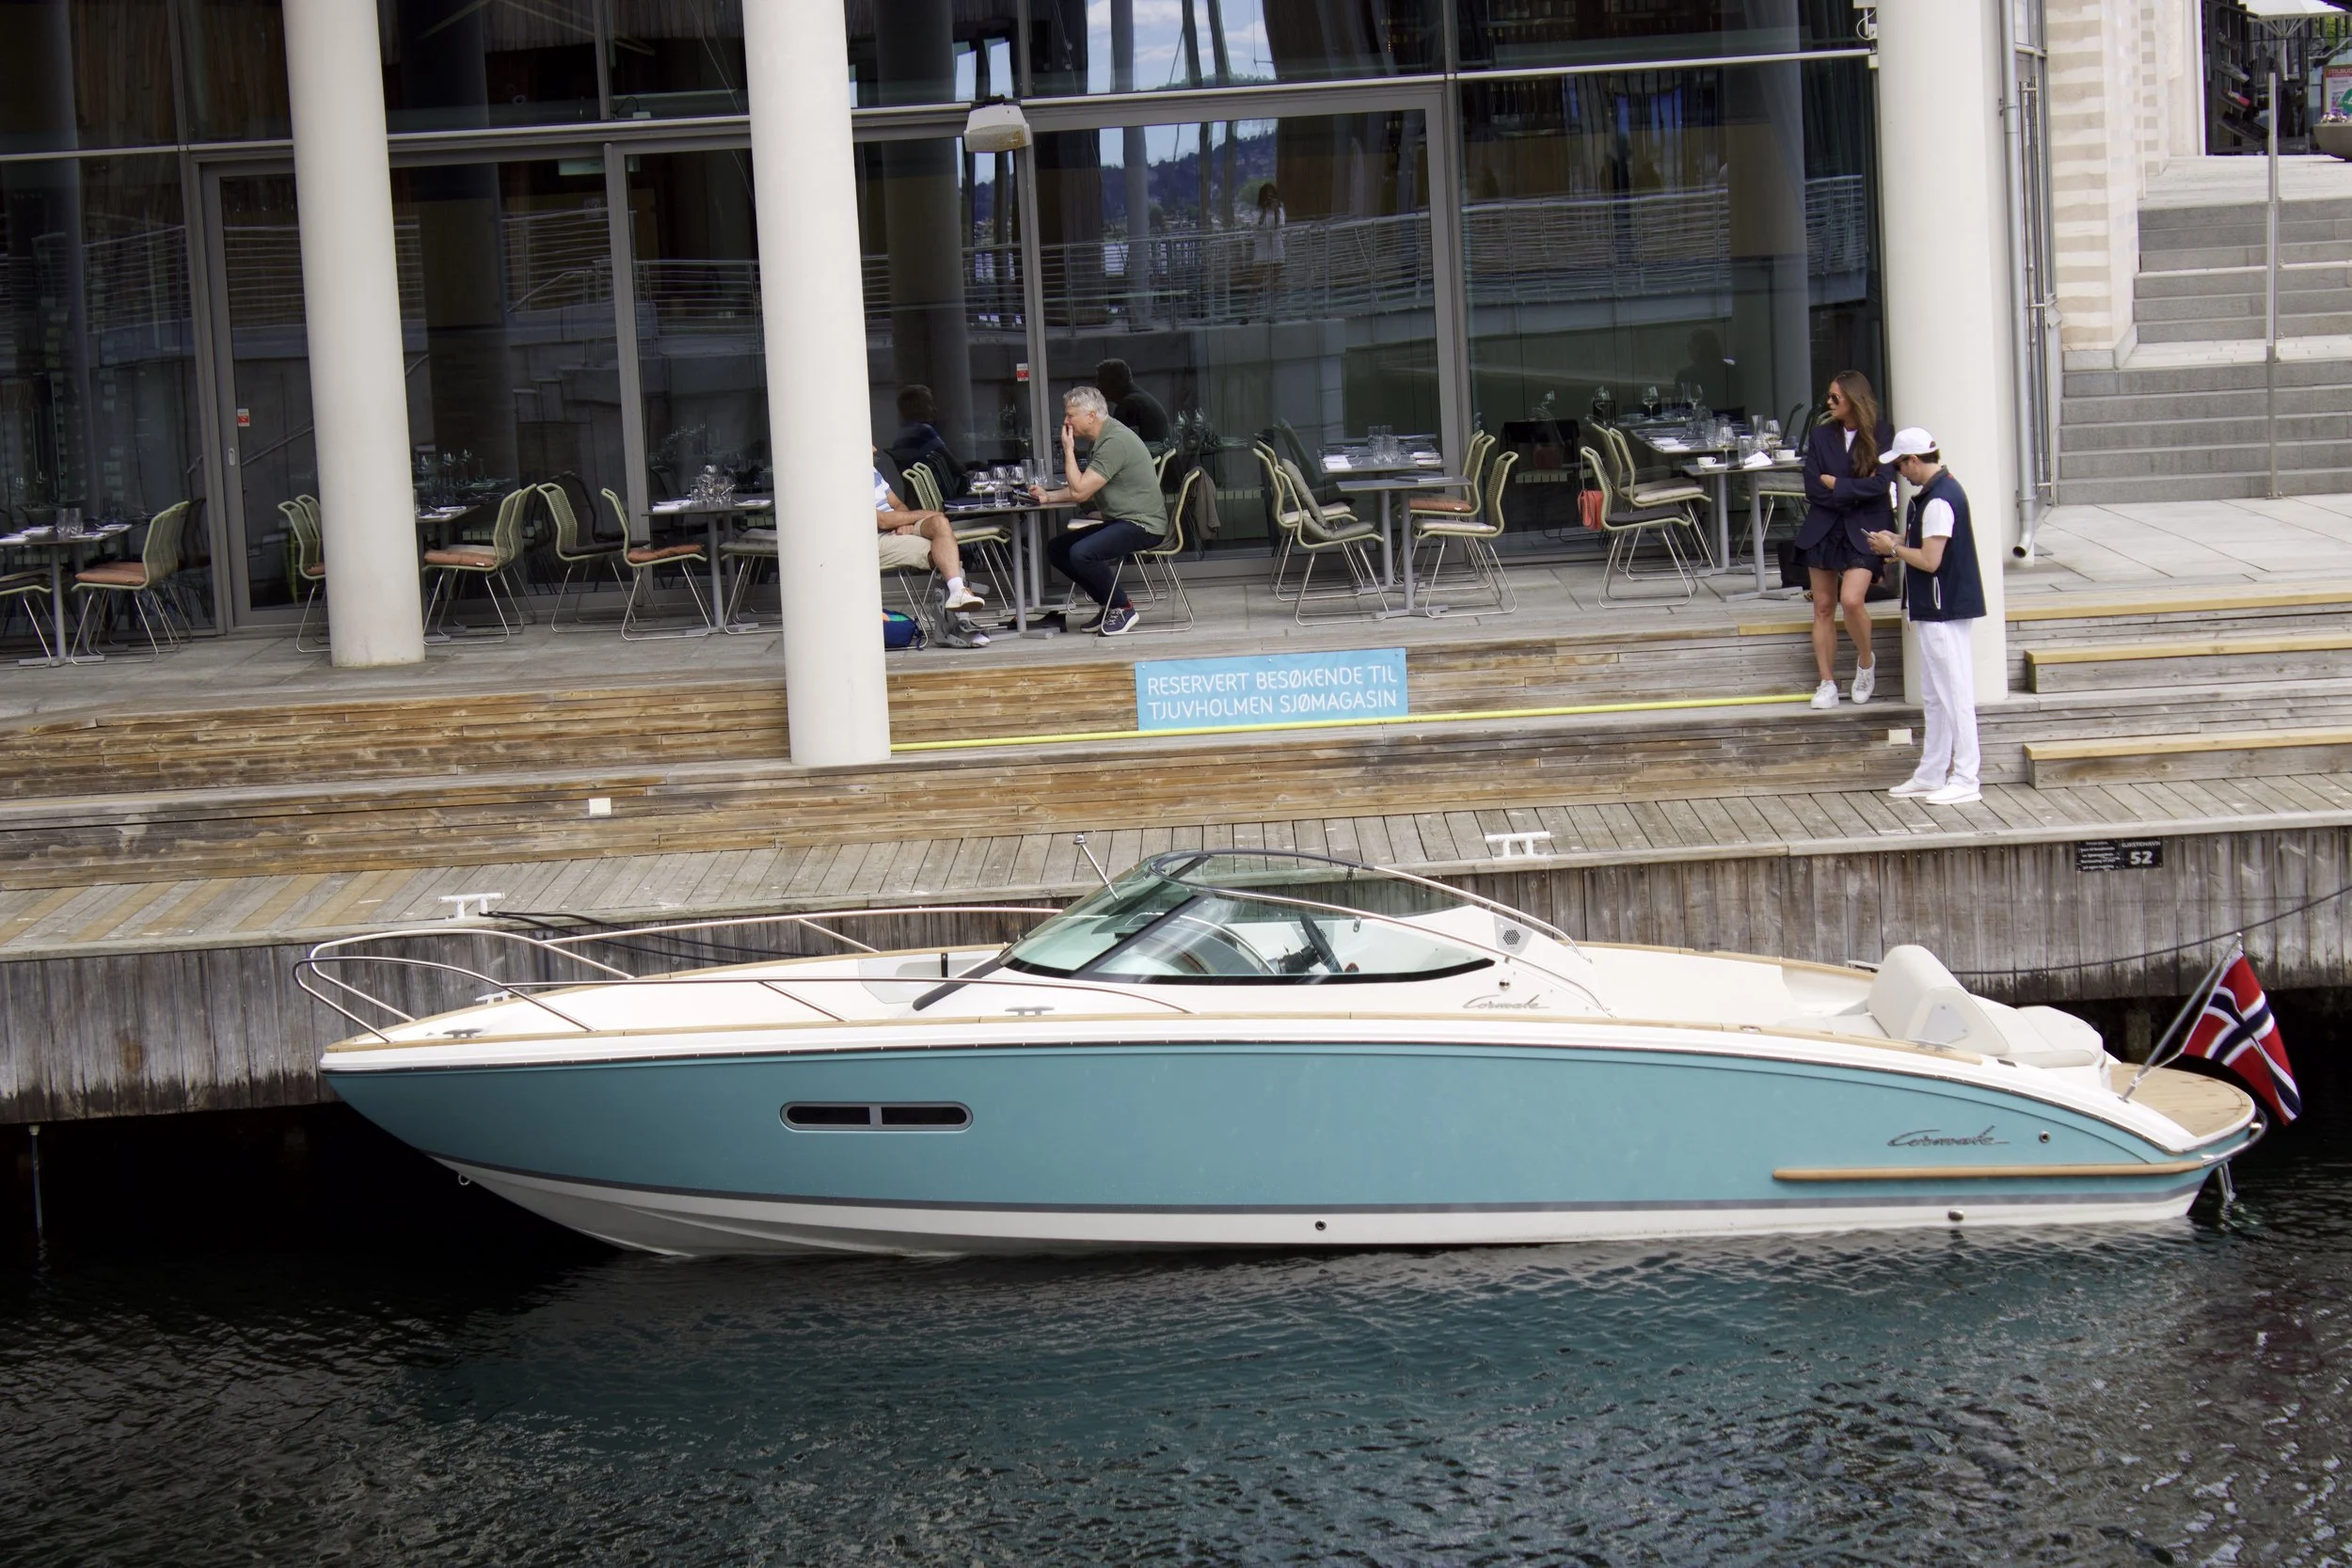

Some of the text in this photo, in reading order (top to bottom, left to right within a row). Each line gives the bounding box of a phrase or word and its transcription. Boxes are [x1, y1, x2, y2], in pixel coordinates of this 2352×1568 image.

[1147, 664, 1397, 696] RESERVERT BESØKENDE TIL
[1147, 689, 1397, 721] TJUVHOLMEN SJØMAGASIN
[2130, 850, 2153, 865] 52
